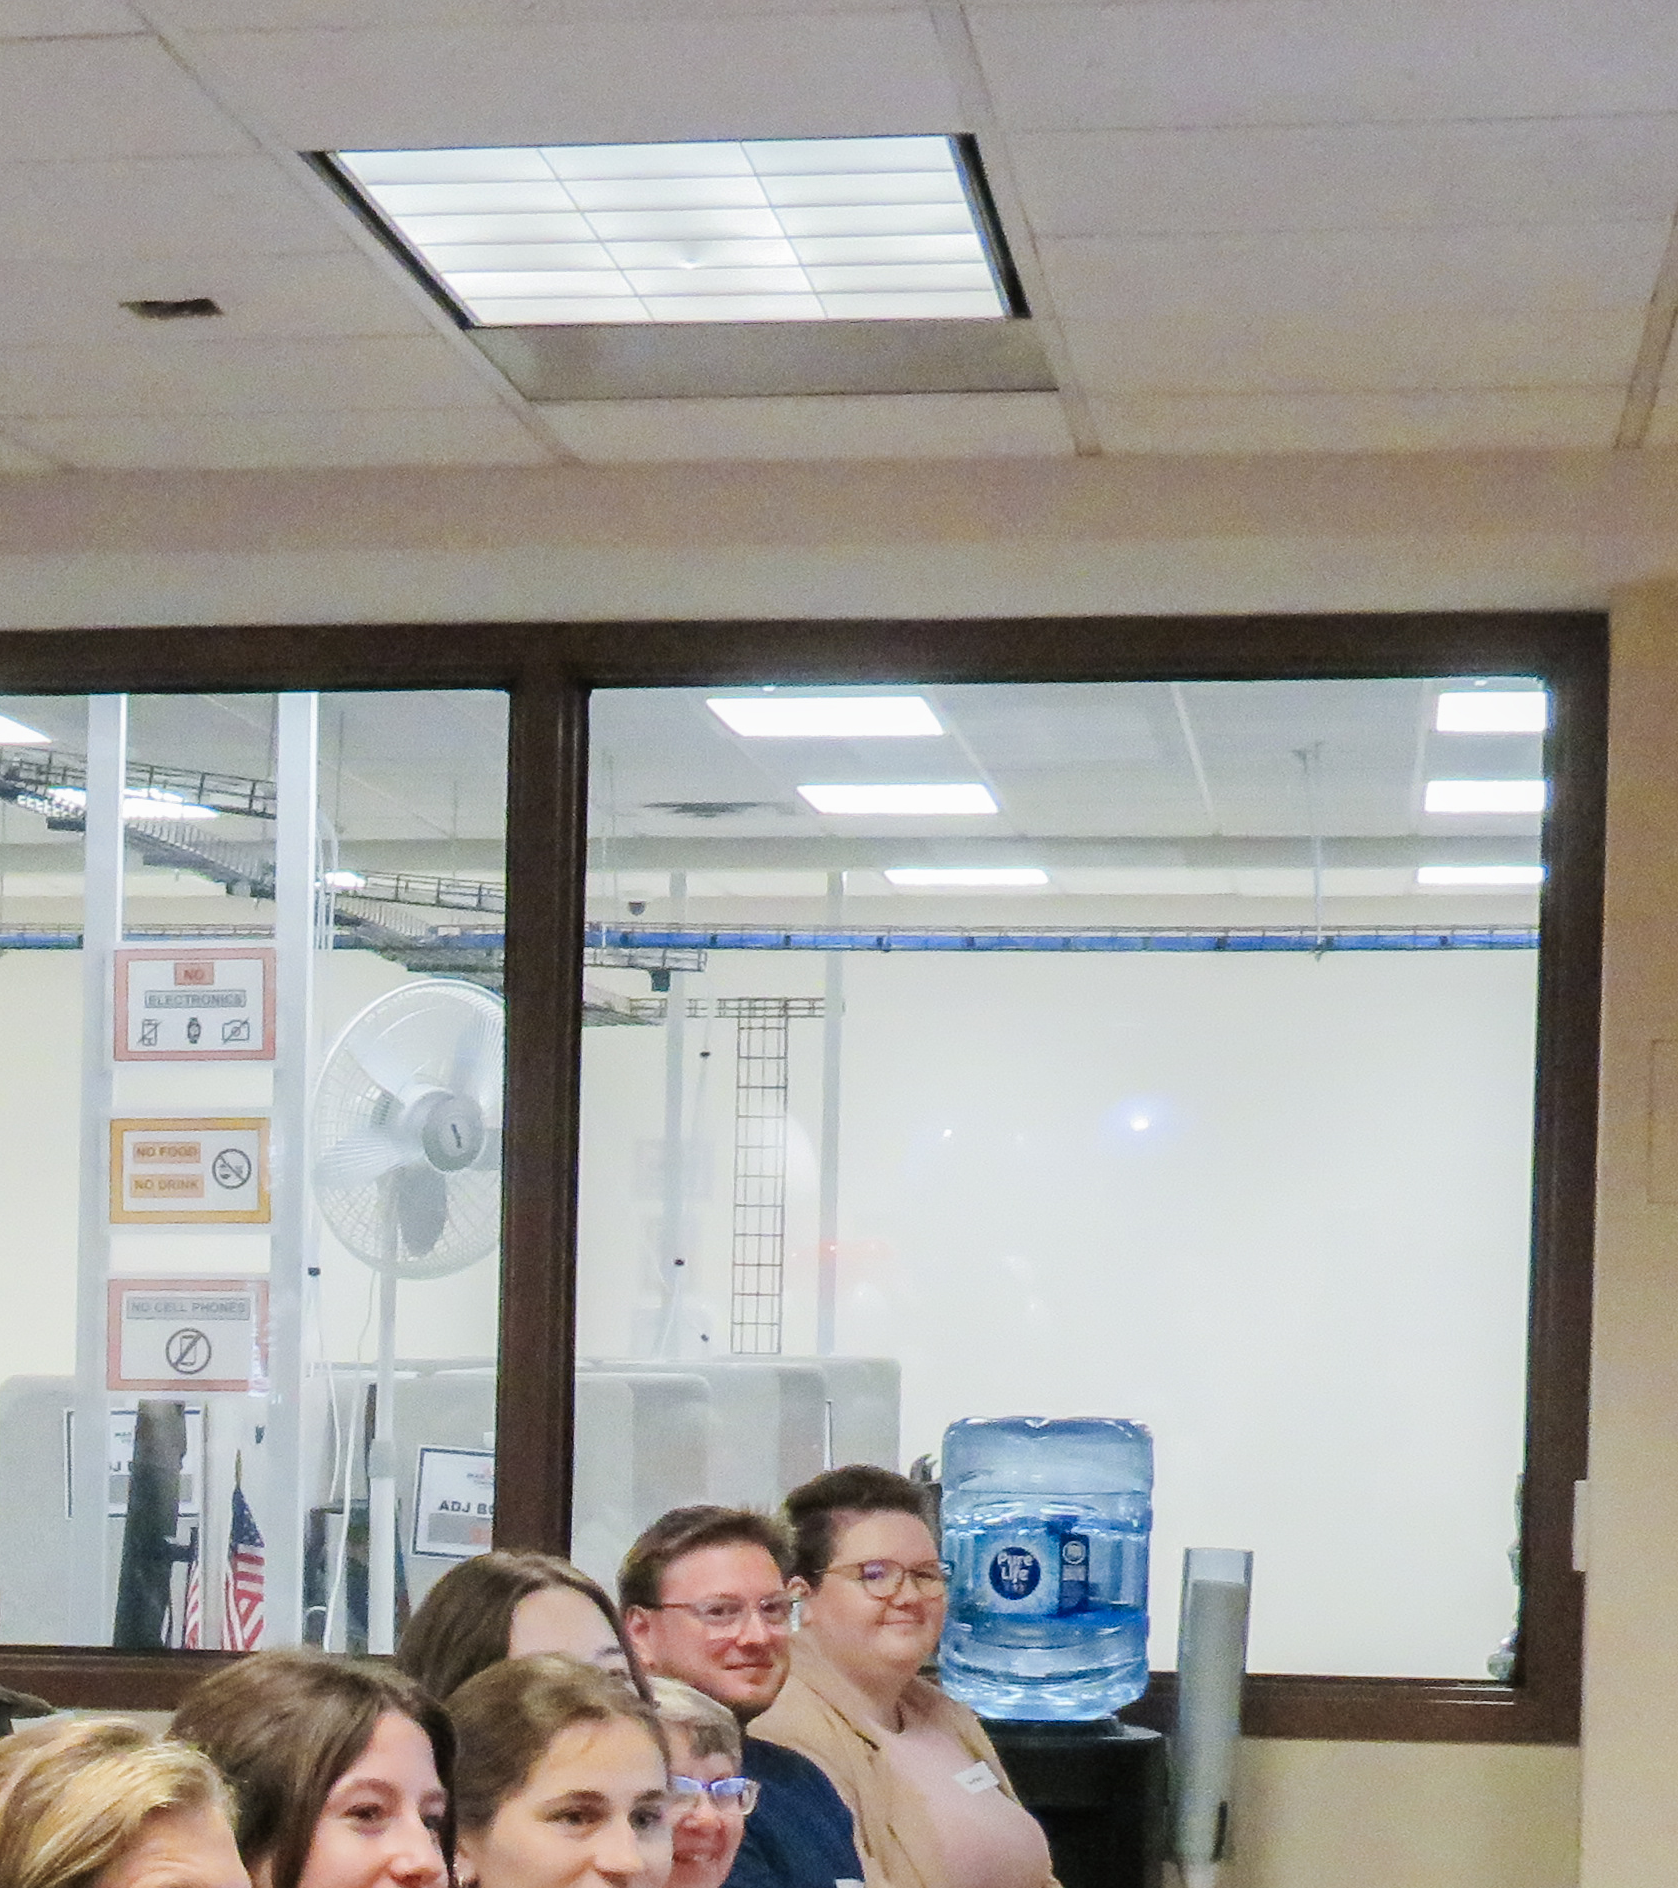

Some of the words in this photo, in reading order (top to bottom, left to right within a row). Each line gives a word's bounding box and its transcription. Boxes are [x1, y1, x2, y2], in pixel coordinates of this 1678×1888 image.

[183, 969, 205, 981] NO
[148, 993, 243, 1006] ELECTRONICS
[137, 1147, 156, 1157] NO
[159, 1146, 198, 1157] FOOD
[134, 1179, 154, 1190] NO
[158, 1179, 199, 1190] DRINK
[131, 1302, 148, 1312] NO
[154, 1302, 187, 1313] CELL
[191, 1302, 246, 1313] PHONES
[438, 1500, 471, 1513] ADJ
